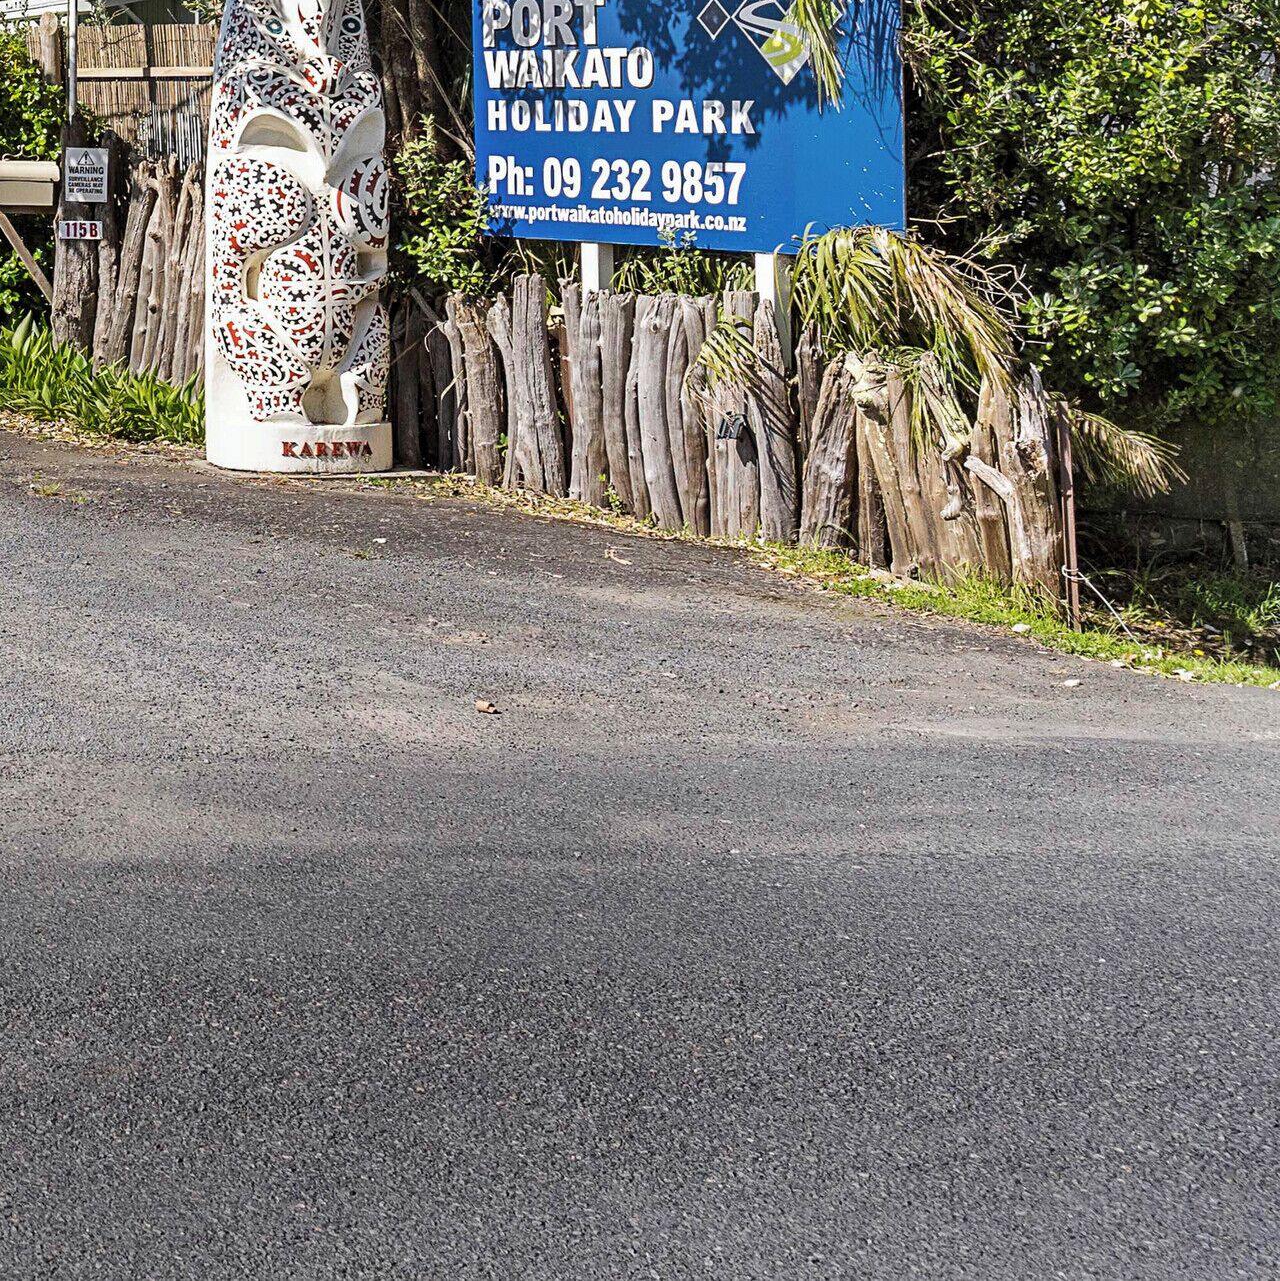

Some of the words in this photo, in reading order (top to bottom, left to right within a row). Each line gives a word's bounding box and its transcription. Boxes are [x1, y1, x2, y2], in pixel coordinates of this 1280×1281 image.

[483, 48, 654, 89] WAIKATO
[487, 99, 637, 133] HOLIDAY
[652, 99, 756, 135] PARK
[68, 166, 103, 174] WARNING
[488, 155, 534, 196] Ph:
[543, 156, 582, 199] 09
[591, 158, 652, 202] 232
[661, 160, 747, 205] 9857
[489, 204, 747, 232] www.portwaikatoholidaypark.co.nz
[281, 441, 373, 458] KAREWA
